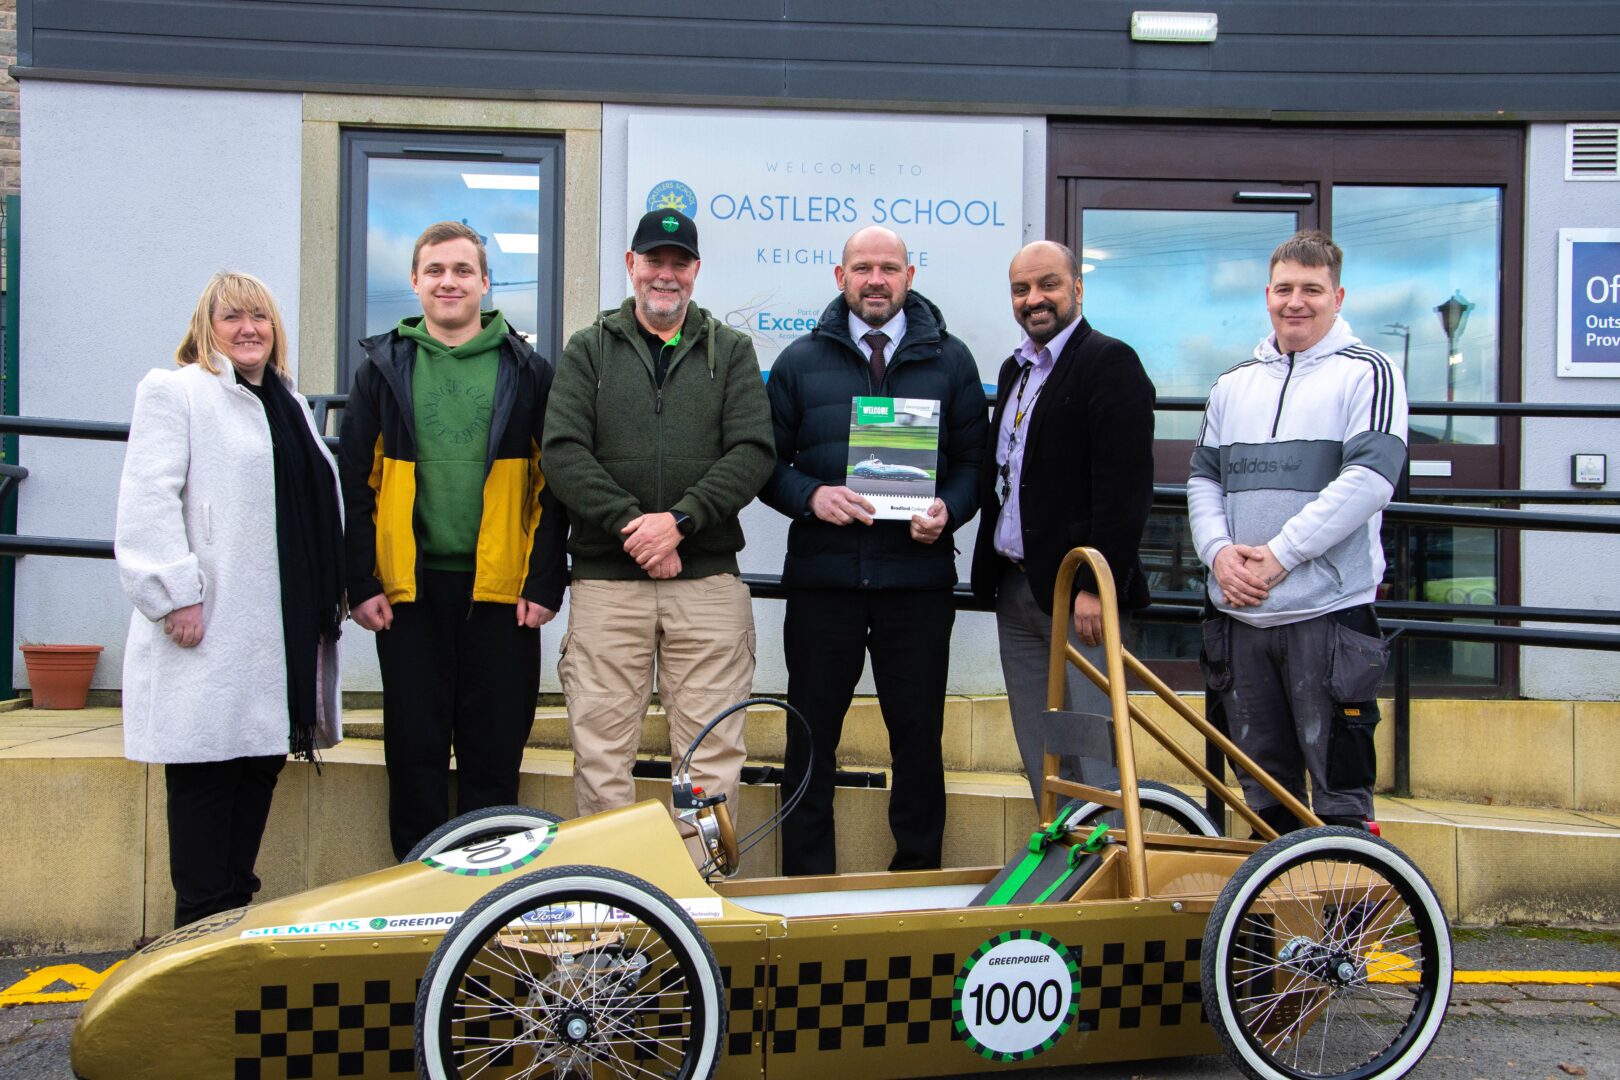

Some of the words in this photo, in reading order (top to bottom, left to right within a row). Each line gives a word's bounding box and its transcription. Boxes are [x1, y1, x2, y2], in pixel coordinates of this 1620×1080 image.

[766, 160, 878, 176] WELCOME
[897, 164, 924, 177] TO
[710, 193, 858, 223] OASTLERS
[871, 197, 1006, 227] SCHOOL
[756, 248, 836, 265] KEIGHL
[908, 252, 929, 267] TE
[1586, 274, 1620, 304] Of
[758, 312, 817, 331] Excee
[1586, 315, 1620, 329] Outs
[1586, 333, 1620, 347] Prov
[863, 406, 889, 416] WELCOME
[1226, 457, 1277, 475] adidas
[389, 916, 459, 928] GREENPO
[530, 909, 565, 922] Ford
[247, 920, 361, 936] SIEMENS
[988, 955, 1050, 966] GREENPOWER
[969, 978, 1063, 1027] 1000
